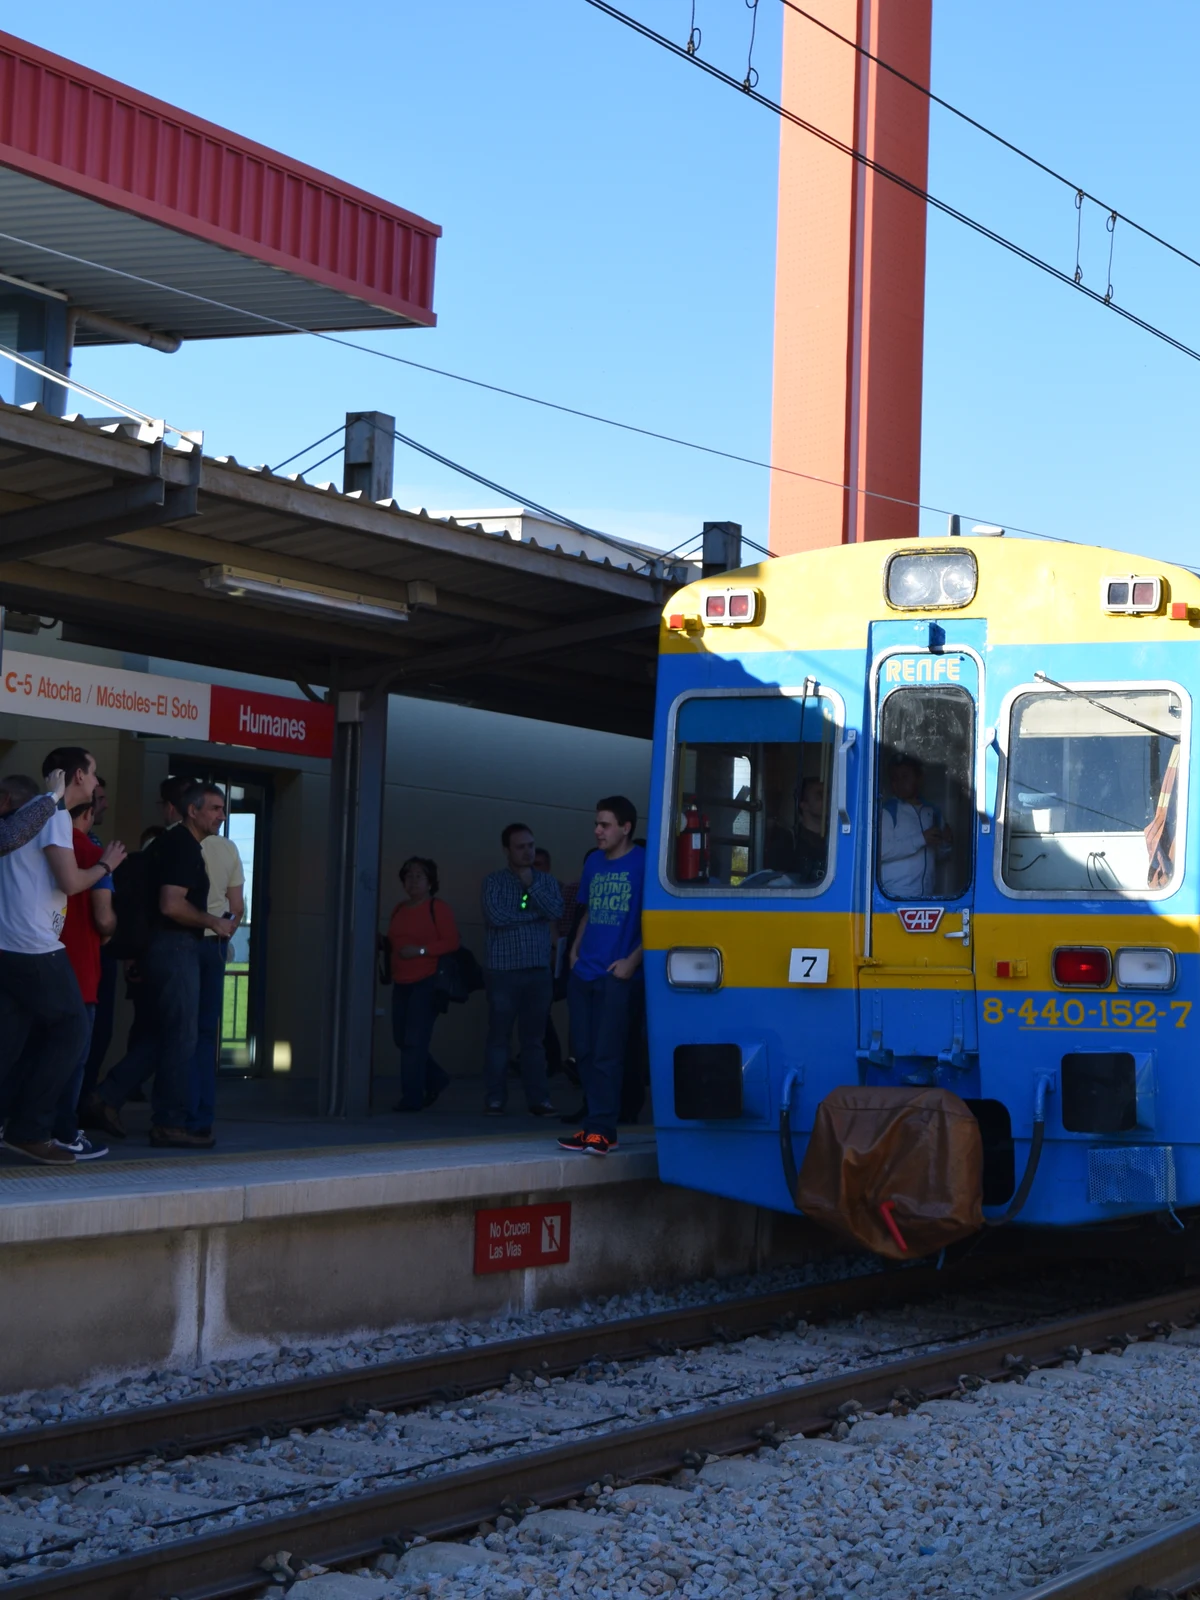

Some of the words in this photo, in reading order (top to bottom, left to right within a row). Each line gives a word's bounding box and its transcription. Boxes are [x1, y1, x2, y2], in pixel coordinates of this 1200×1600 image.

[886, 658, 961, 682] RENFE
[5, 671, 33, 697] C-5
[37, 676, 82, 704] Atocha
[96, 686, 169, 716] Móstoles-El
[172, 697, 199, 721] Soto
[239, 704, 307, 741] Humanes
[589, 881, 632, 898] SOUND
[904, 910, 939, 929] CAF
[801, 956, 818, 978] 7
[982, 997, 1193, 1028] 8-440-152-7
[489, 1222, 502, 1238] No
[503, 1220, 531, 1237] Crucen
[489, 1243, 503, 1259] Las
[506, 1240, 522, 1257] Vías
